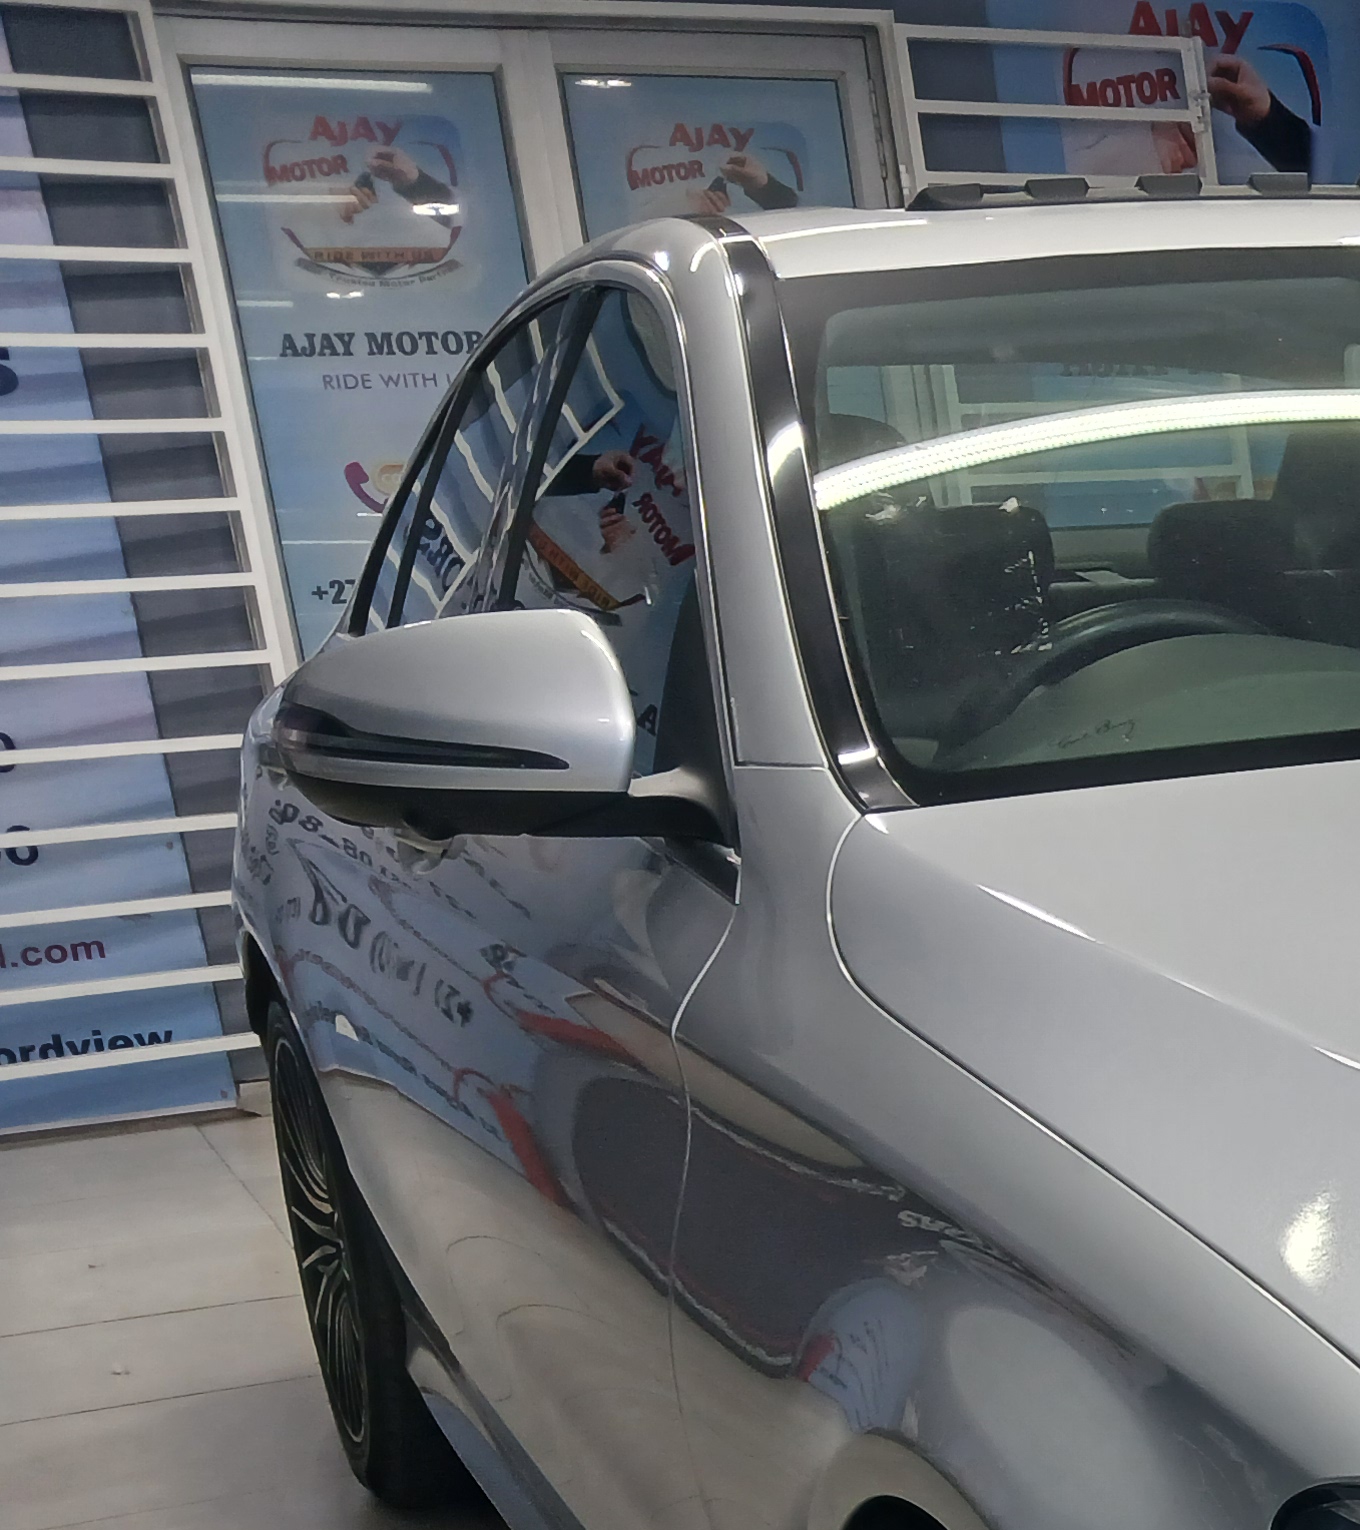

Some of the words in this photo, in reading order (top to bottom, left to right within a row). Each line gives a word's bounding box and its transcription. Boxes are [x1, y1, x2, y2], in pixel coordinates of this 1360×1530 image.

[1065, 67, 1181, 107] MOTOR
[309, 115, 403, 147] AJAY
[668, 122, 755, 152] AJAY
[264, 153, 349, 187] MOTOR
[627, 159, 706, 191] MOTOR
[279, 332, 356, 358] AJAY
[322, 373, 373, 391] RIDE
[378, 372, 439, 389] WITH
